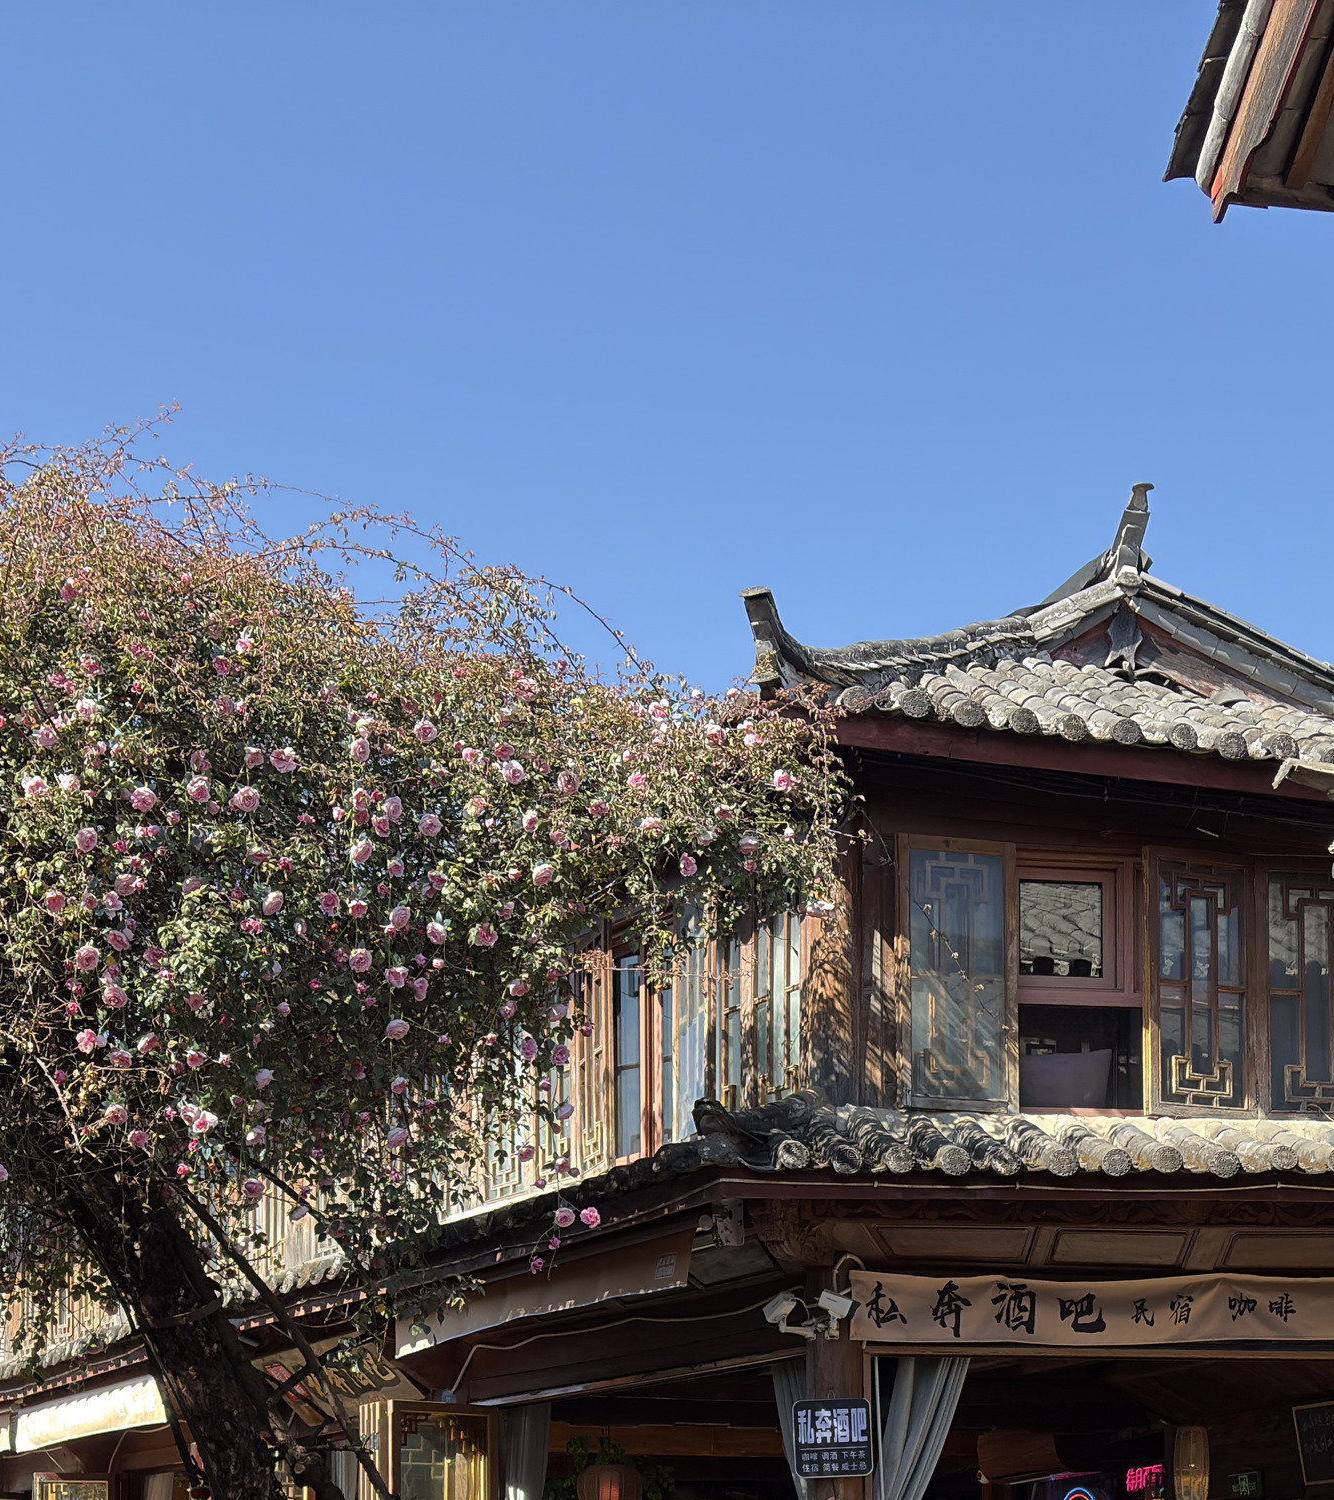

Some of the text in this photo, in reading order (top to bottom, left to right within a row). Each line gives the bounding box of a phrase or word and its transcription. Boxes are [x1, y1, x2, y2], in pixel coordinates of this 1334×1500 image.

[866, 1280, 1106, 1338] 私奔酒吧
[1131, 1294, 1195, 1327] 民宿
[1228, 1292, 1297, 1322] 咖啡
[797, 1408, 868, 1444] 私奔酒吧
[841, 1450, 865, 1459] 下午茶
[802, 1461, 867, 1472] 住宿 简餐 威士忌
